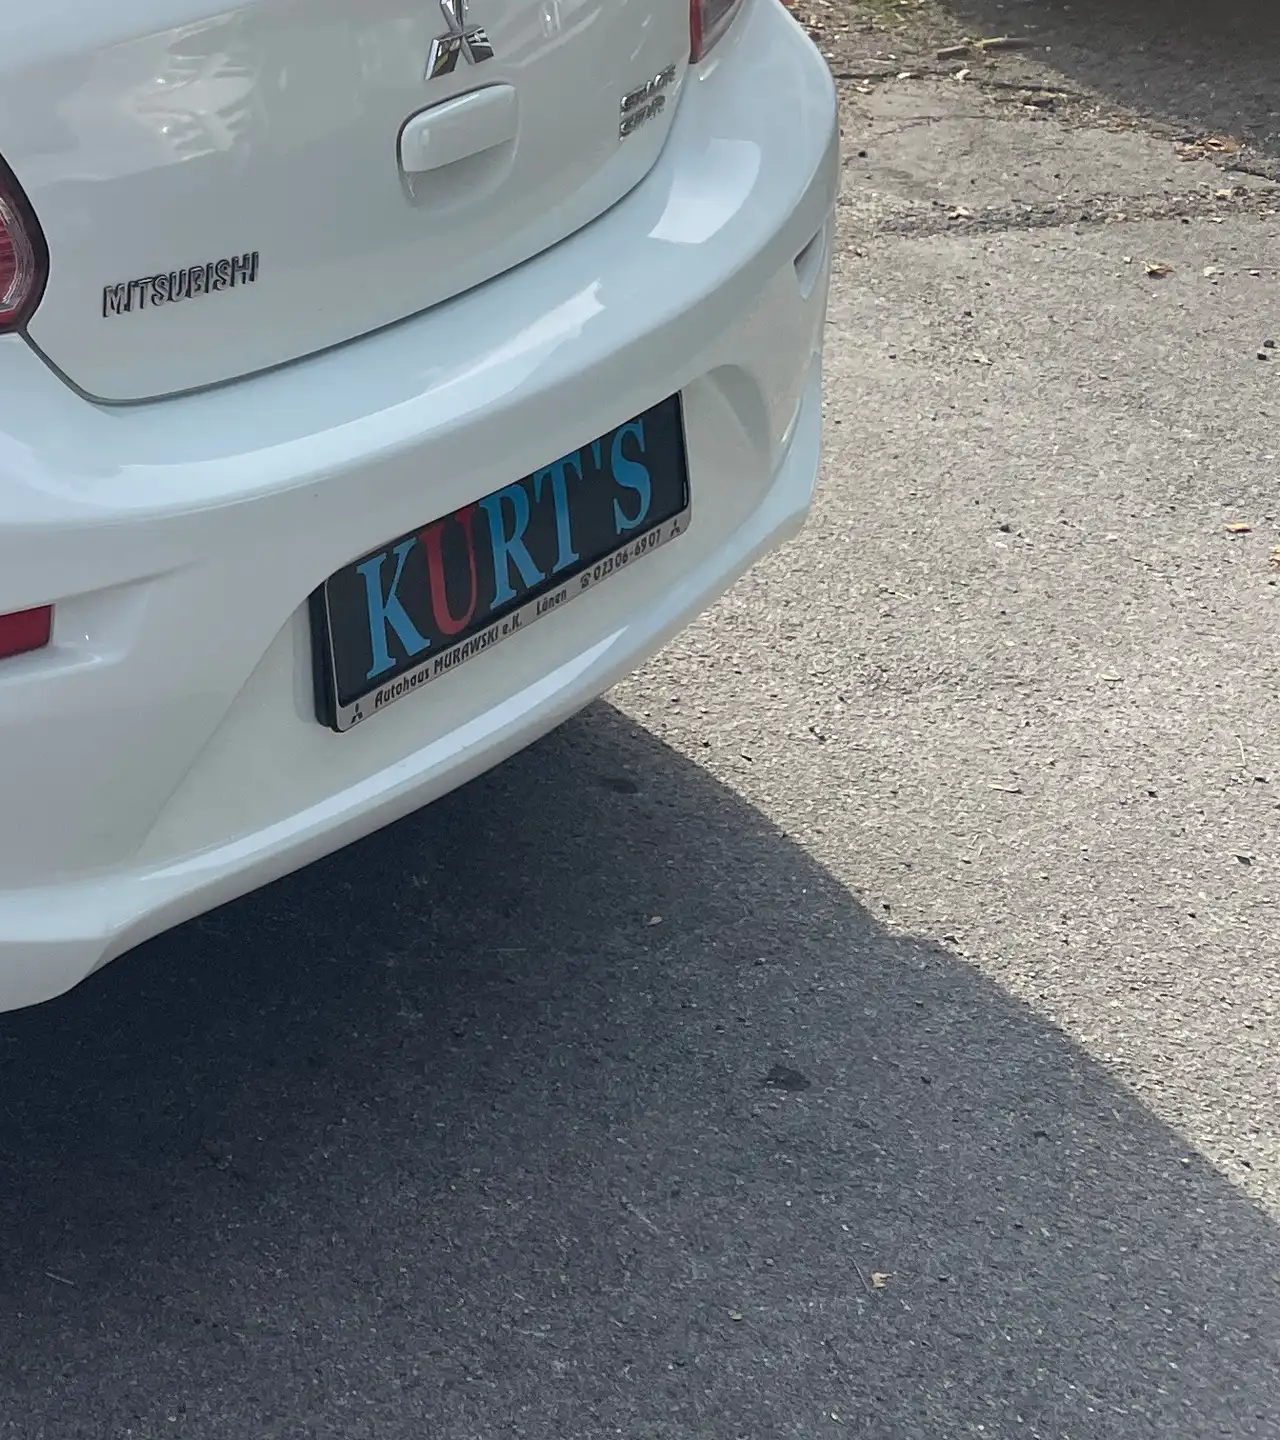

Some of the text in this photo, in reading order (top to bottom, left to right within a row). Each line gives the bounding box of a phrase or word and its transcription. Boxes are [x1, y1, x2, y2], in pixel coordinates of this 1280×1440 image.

[102, 251, 260, 318] MITSUBISHI
[357, 419, 652, 680] KURT'S
[375, 666, 430, 708] Autohaus
[434, 624, 499, 678] MURAWSKI
